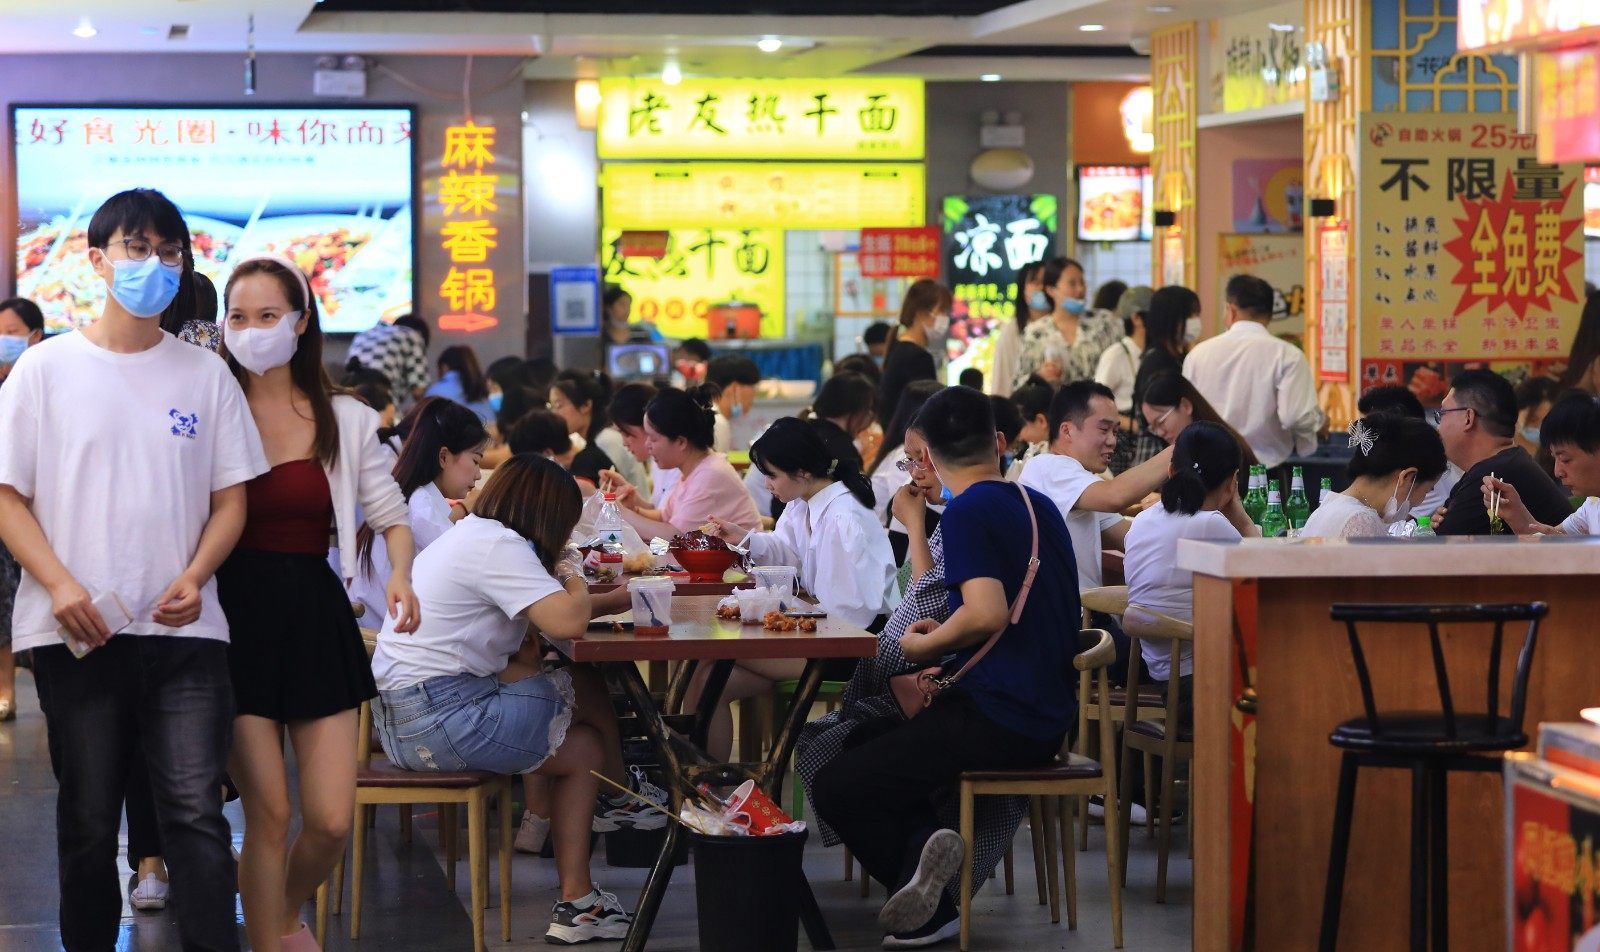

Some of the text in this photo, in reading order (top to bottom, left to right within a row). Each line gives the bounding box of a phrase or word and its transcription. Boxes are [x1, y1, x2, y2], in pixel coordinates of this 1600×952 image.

[17, 117, 411, 145] 好食光圈·味你而
[629, 91, 897, 137] 老友热干面
[1398, 127, 1463, 143] 自助火锅
[1379, 158, 1565, 201] 不限量
[439, 121, 498, 312] 麻辣香锅
[954, 213, 1049, 276] 凉面
[1470, 203, 1562, 297] 全免费
